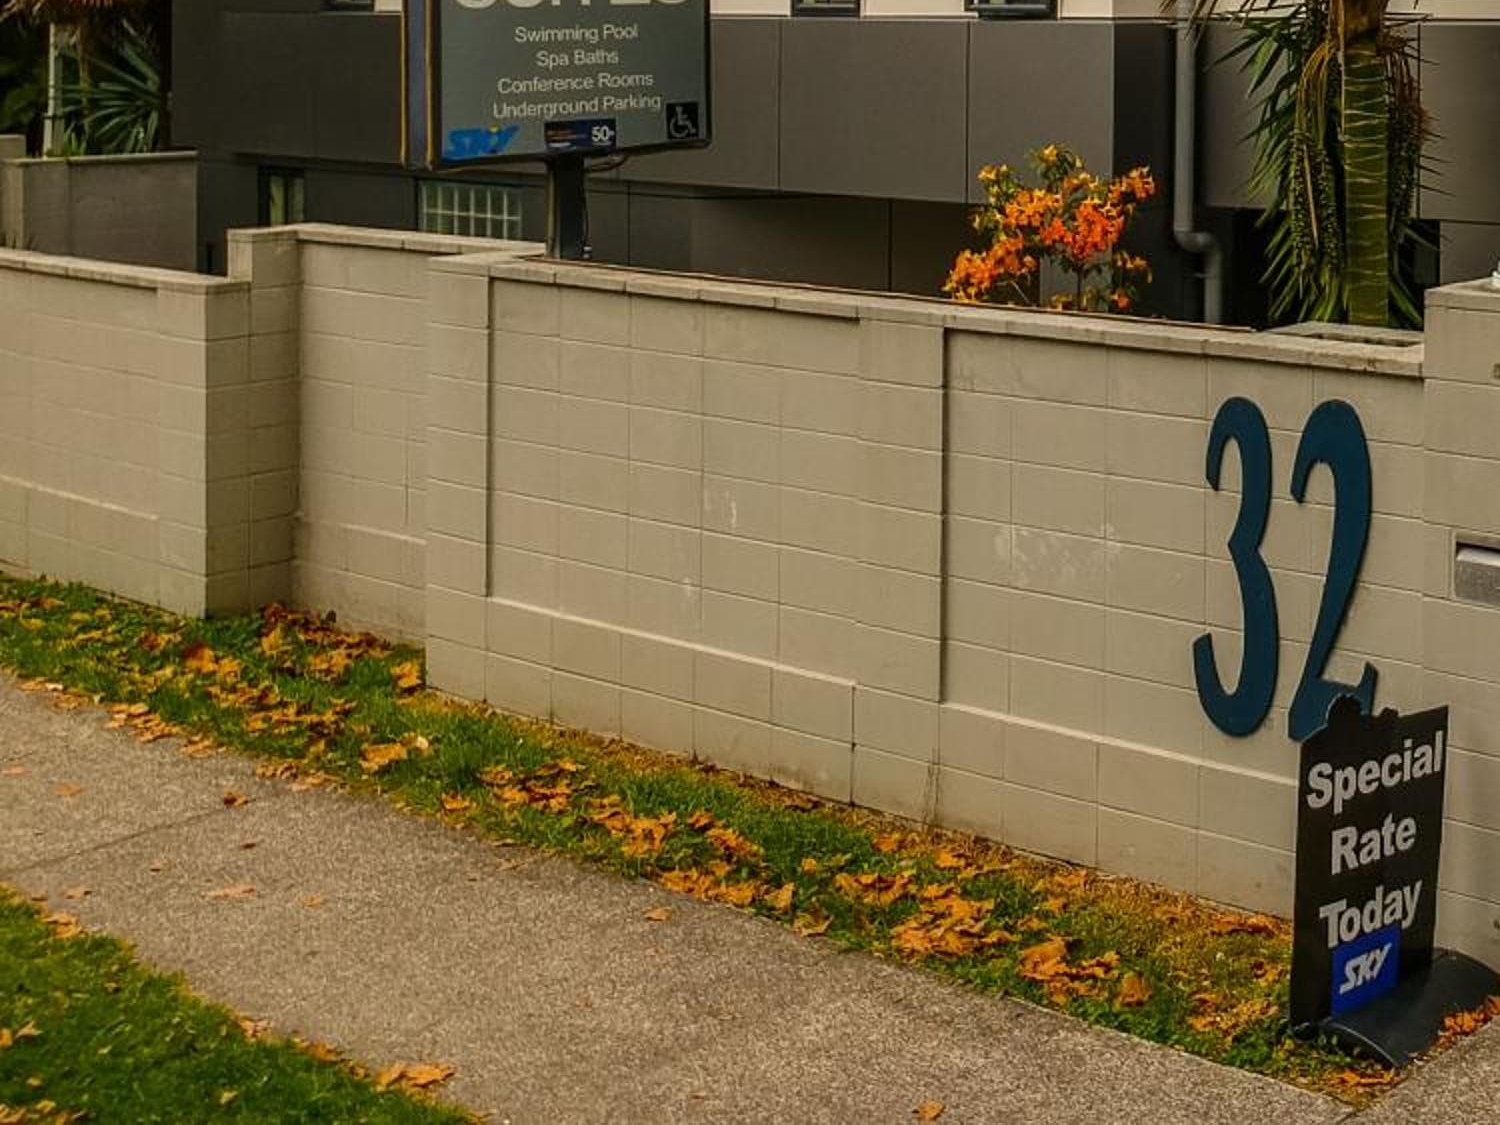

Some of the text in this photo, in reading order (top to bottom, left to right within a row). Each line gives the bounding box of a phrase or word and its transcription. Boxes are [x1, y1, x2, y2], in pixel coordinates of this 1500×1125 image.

[514, 23, 639, 44] Swimming Pool
[535, 49, 619, 69] Spa Baths
[493, 94, 663, 120] Underground Parking
[497, 73, 654, 95] Conference Rooms
[1193, 396, 1377, 741] 32
[1306, 729, 1444, 815] Special
[1331, 812, 1418, 875] Rate
[1318, 879, 1423, 949] Today
[1338, 941, 1393, 995] SKY
